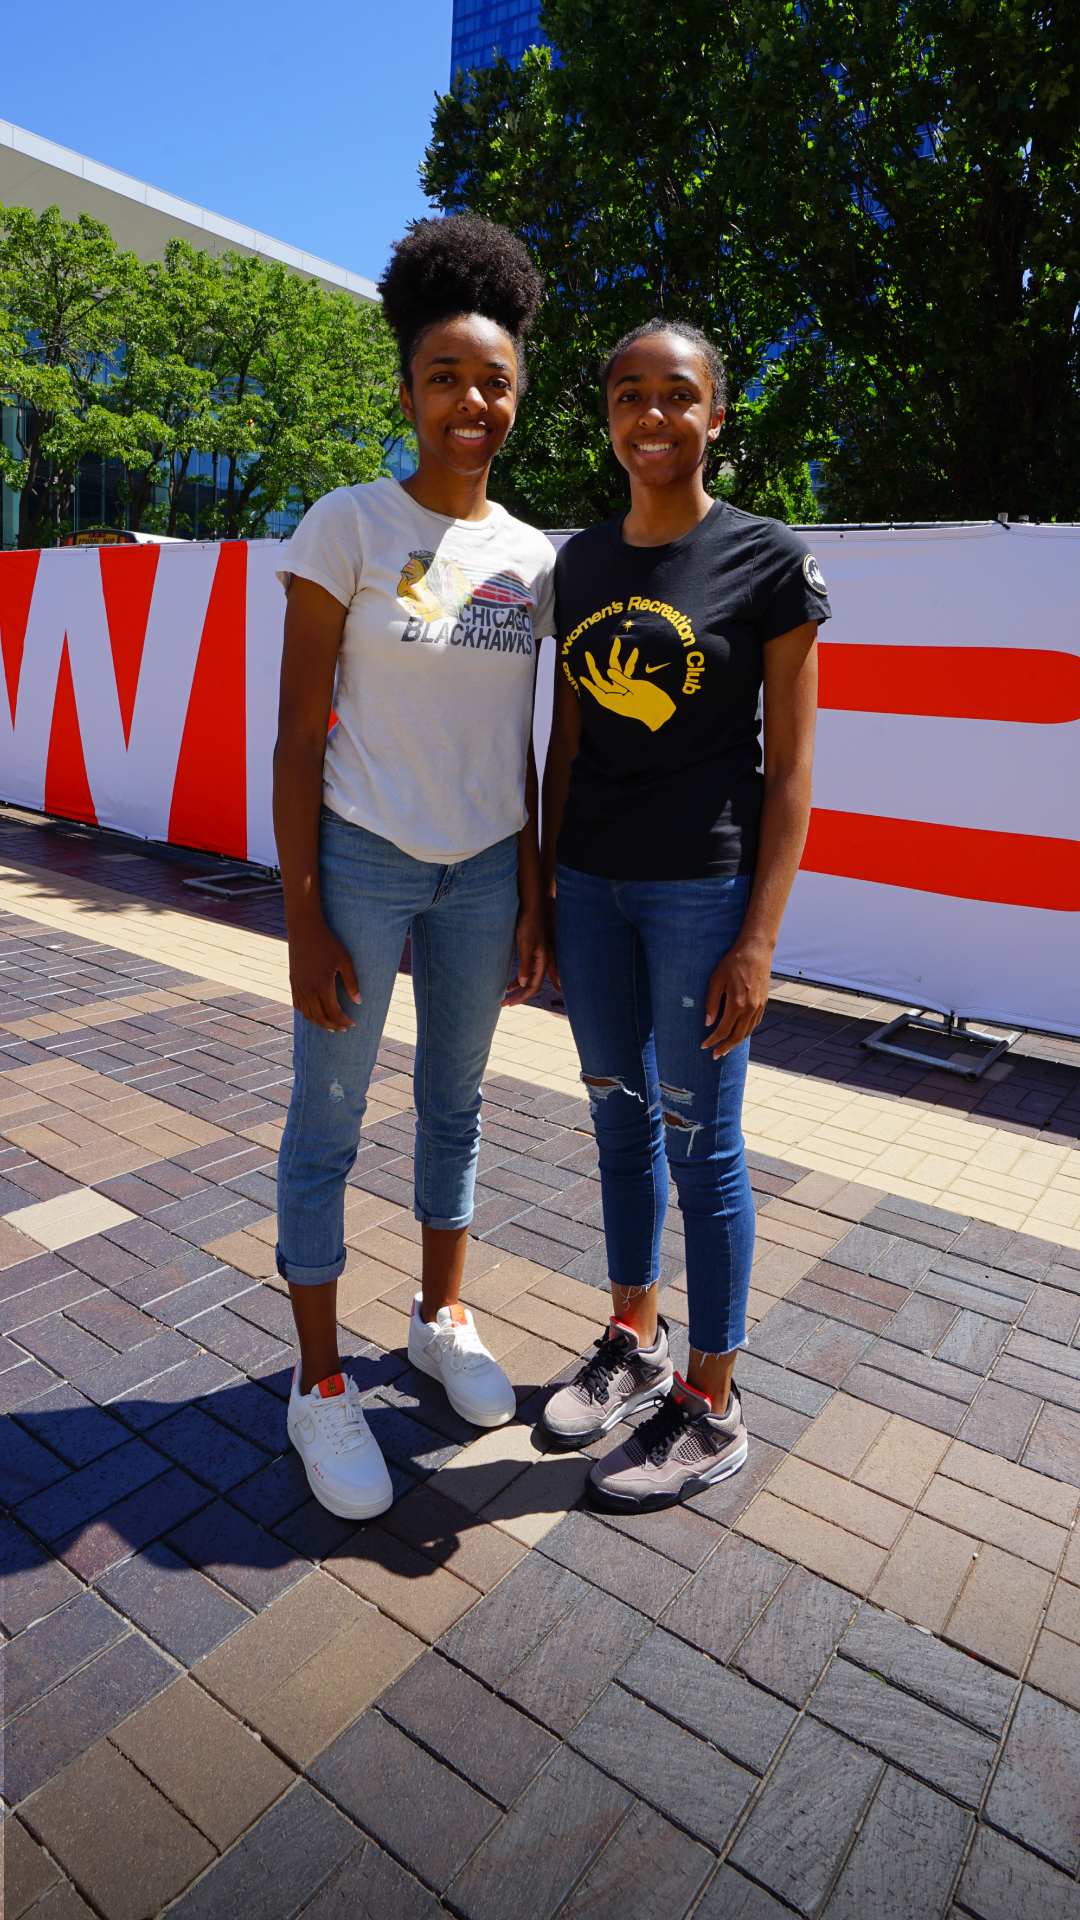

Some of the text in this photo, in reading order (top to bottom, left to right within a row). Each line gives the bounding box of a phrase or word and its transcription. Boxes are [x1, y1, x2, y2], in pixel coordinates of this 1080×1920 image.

[401, 616, 532, 655] BLACKHAWKS
[459, 604, 532, 632] CHICAGO
[627, 596, 696, 647] Recreation
[682, 651, 705, 695] Club
